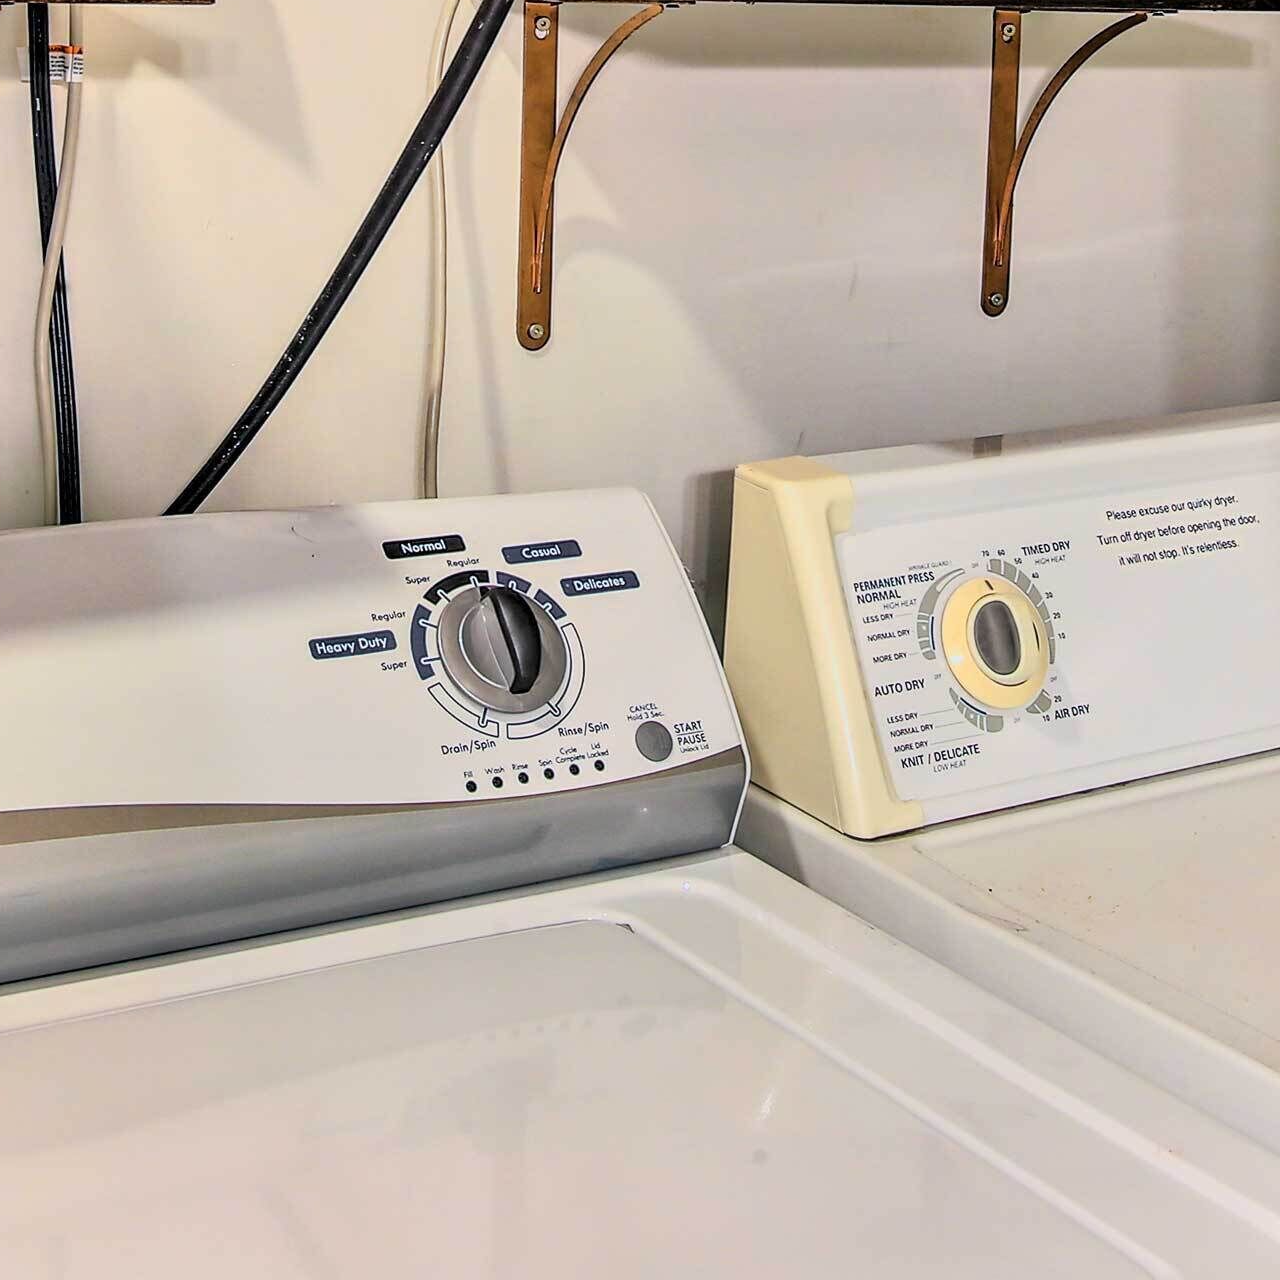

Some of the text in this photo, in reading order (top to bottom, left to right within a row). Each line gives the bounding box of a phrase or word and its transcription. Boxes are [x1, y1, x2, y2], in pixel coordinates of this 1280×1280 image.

[1106, 495, 1238, 520] Please excuse our quirky dryer.
[1097, 535, 1119, 546] Turn
[1120, 531, 1133, 543] off
[1134, 529, 1156, 542] dryer
[1157, 524, 1186, 537] before
[1187, 519, 1221, 533] opening
[1222, 517, 1236, 527] the
[400, 539, 447, 554] Normal
[522, 545, 561, 558] Casual
[1021, 540, 1071, 556] TIMED DRY
[1051, 554, 1066, 562] HEAT
[1126, 553, 1141, 564] will
[1143, 550, 1157, 561] not
[1159, 549, 1180, 560] stop.
[1182, 544, 1195, 556] It's
[446, 557, 480, 568] Regular
[405, 575, 431, 585] Super
[573, 577, 625, 591] Delicates
[854, 571, 935, 593] PERMANENT PRESS
[857, 589, 901, 604] NORMAL
[883, 598, 917, 610] HIGH HEAT
[371, 610, 407, 622] Regular
[862, 613, 894, 624] LESS DRY
[867, 629, 910, 642] NORMAL DRY
[316, 637, 387, 655] Heavy Duty
[873, 652, 907, 664] MORE DRY
[380, 660, 408, 671] Super
[874, 679, 925, 697] AUTO DRY
[629, 703, 658, 713] CANCEL
[1054, 709, 1070, 720] AIR
[1071, 704, 1090, 717] DRY
[626, 713, 643, 721] Hold
[887, 712, 918, 724] LESS DRY
[558, 721, 609, 737] Rinse/Spin
[674, 720, 703, 733] START
[890, 723, 934, 738] NORMAL DRY
[677, 733, 707, 746] PAUSE
[441, 739, 496, 755] Drain/Spin
[559, 747, 577, 756] Cycle
[894, 740, 928, 753] MORE DRY
[555, 754, 586, 764] Complete
[587, 749, 609, 759] Locked
[900, 743, 980, 769] KNIT DELICATE
[538, 759, 552, 768] Spin
[933, 759, 966, 773] LOW HEAT
[484, 767, 505, 775] Wash
